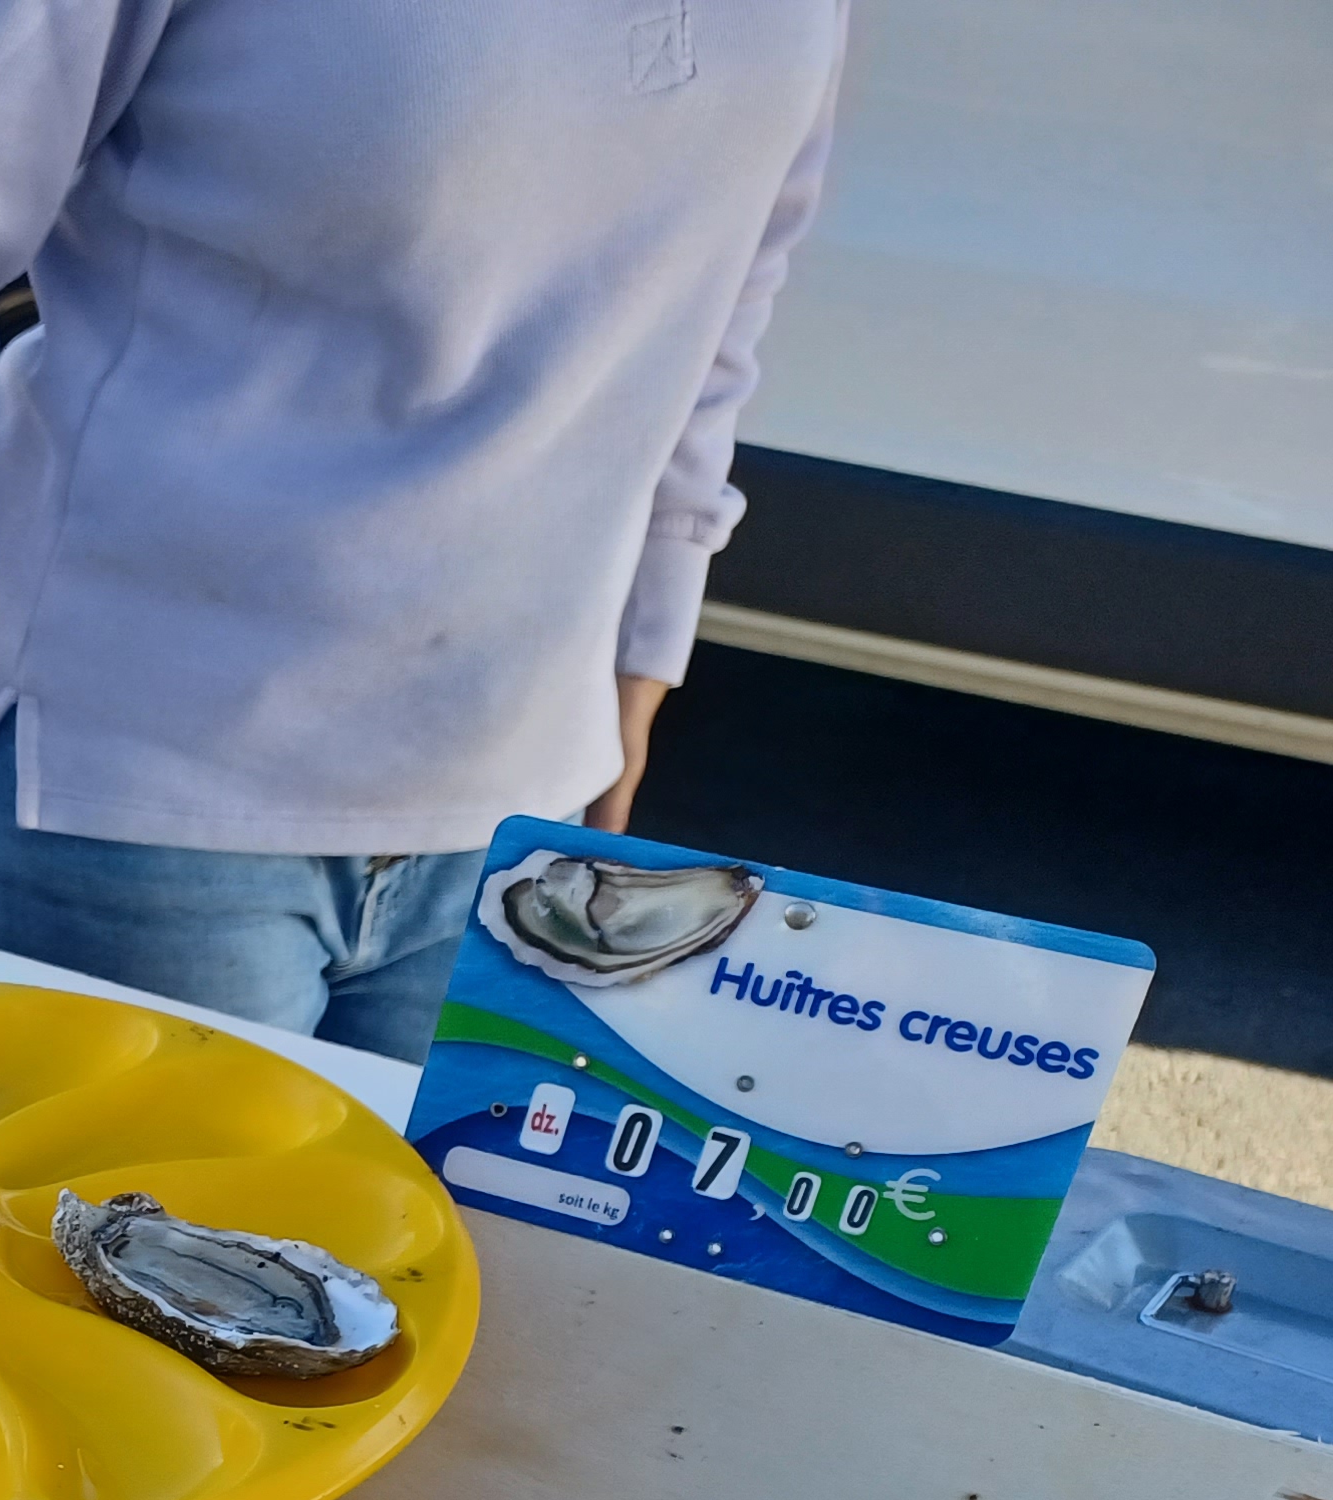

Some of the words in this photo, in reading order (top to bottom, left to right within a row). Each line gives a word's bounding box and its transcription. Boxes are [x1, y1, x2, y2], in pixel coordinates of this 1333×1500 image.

[709, 957, 887, 1033] Huîtres
[899, 1008, 1100, 1080] creuses
[530, 1103, 560, 1137] dz.
[557, 1190, 584, 1210] soit
[586, 1196, 601, 1214] le
[602, 1200, 622, 1222] kg
